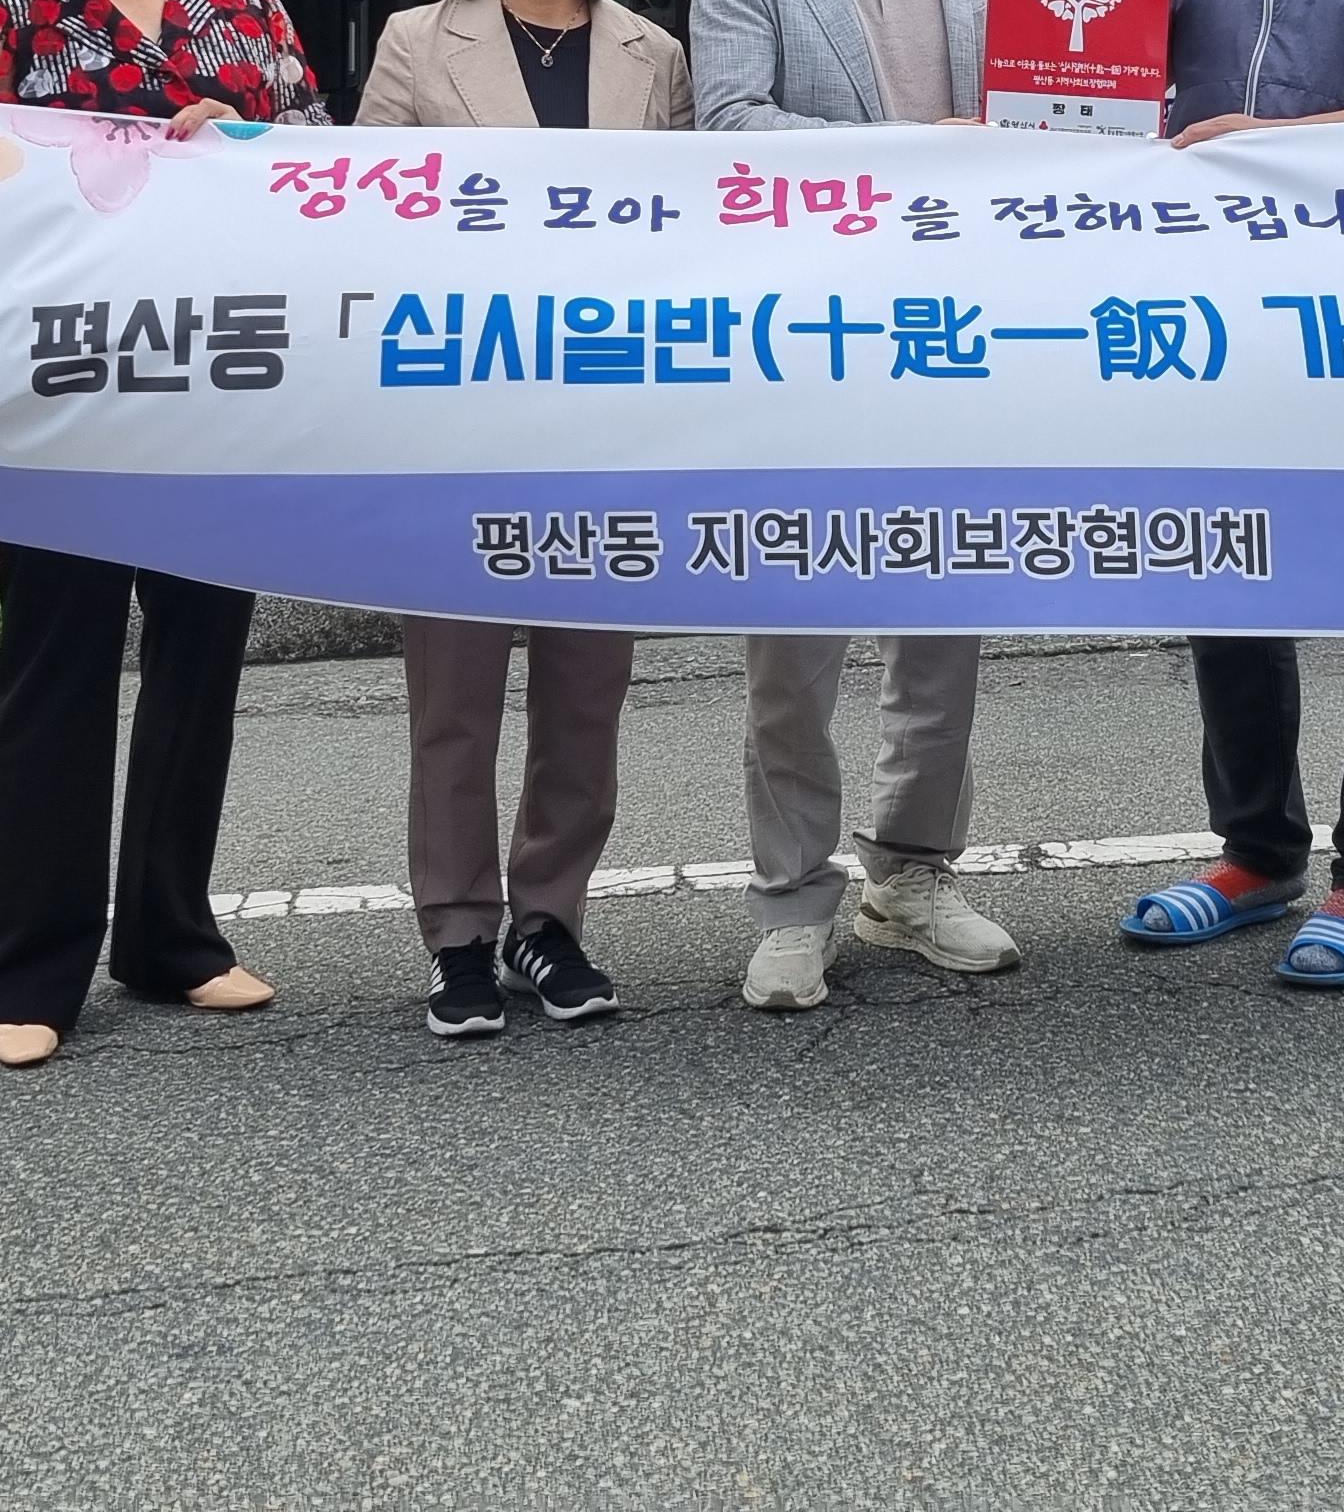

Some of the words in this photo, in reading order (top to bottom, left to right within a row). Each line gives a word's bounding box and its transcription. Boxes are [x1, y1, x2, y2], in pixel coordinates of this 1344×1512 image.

[268, 152, 510, 232] 정성을
[542, 185, 681, 233] 모아
[716, 162, 964, 241] 희망을
[29, 292, 290, 398] 평산동
[472, 510, 663, 581] 평산동
[687, 504, 1275, 581] 지역사회보장협의체
